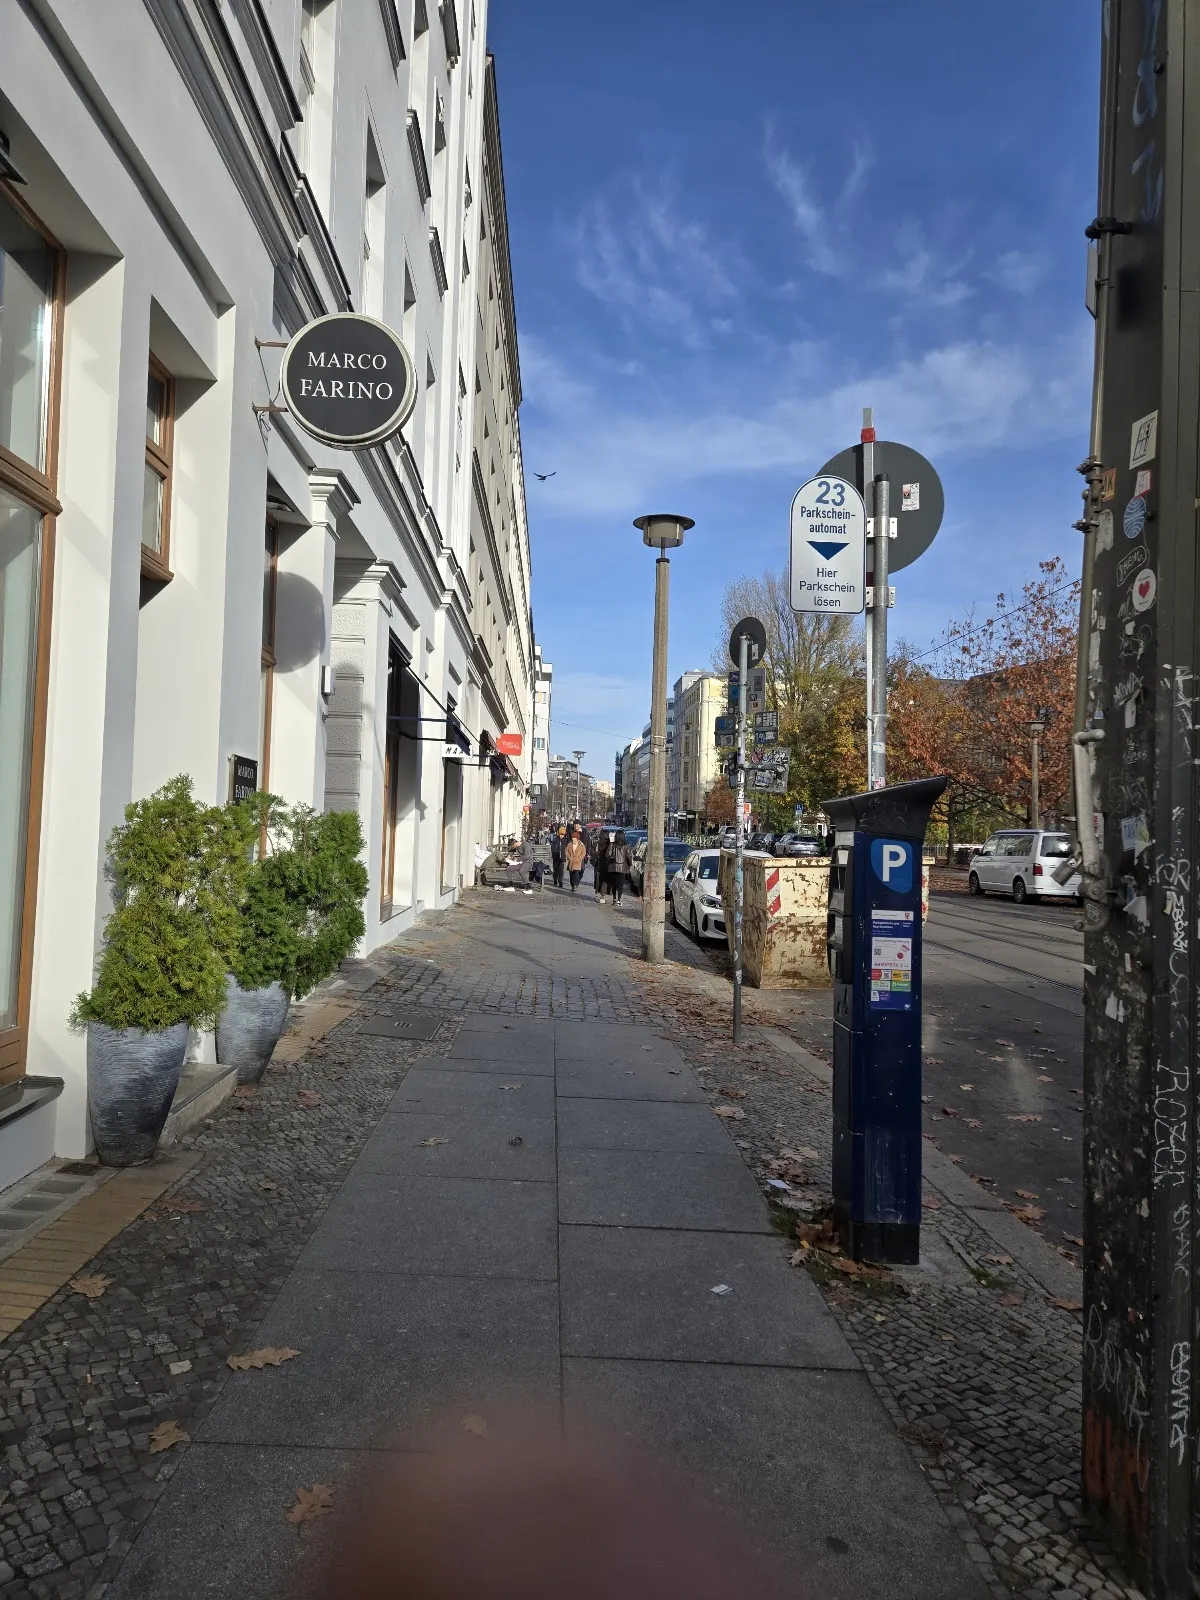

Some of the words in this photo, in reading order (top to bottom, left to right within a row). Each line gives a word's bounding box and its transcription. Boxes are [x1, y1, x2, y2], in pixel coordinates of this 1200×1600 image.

[307, 351, 387, 370] MARCO
[299, 378, 393, 400] FARINO
[815, 480, 846, 507] 23
[800, 506, 856, 520] Parkschein-
[809, 523, 847, 534] automat
[816, 568, 838, 578] Hier
[799, 581, 855, 593] Parkschein
[813, 596, 841, 607] lösen
[882, 844, 907, 882] P
